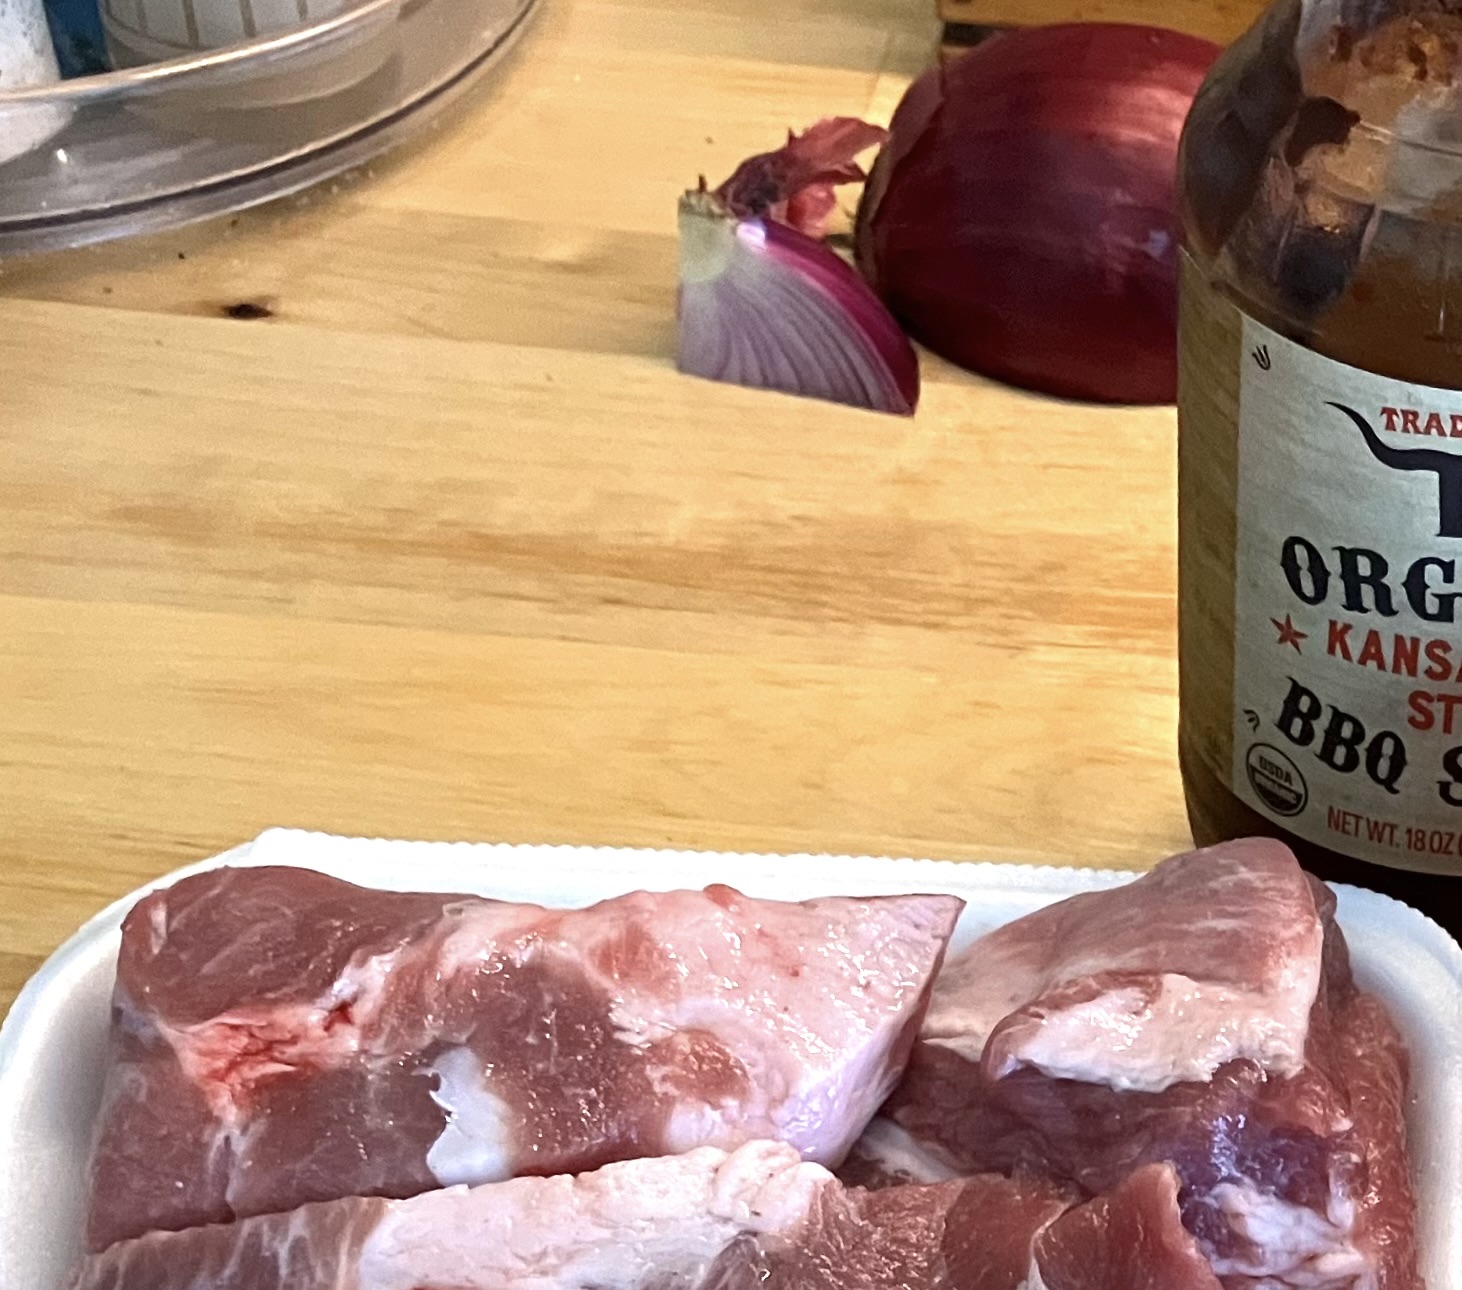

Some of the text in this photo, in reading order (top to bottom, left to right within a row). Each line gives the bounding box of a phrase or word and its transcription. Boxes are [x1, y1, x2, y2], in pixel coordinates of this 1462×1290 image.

[1273, 675, 1408, 795] BBQ
[1258, 755, 1293, 787] USDA
[1327, 805, 1364, 838] NET
[1366, 817, 1400, 848] WT.
[1405, 828, 1426, 850] 18
[1428, 830, 1454, 856] OZ
